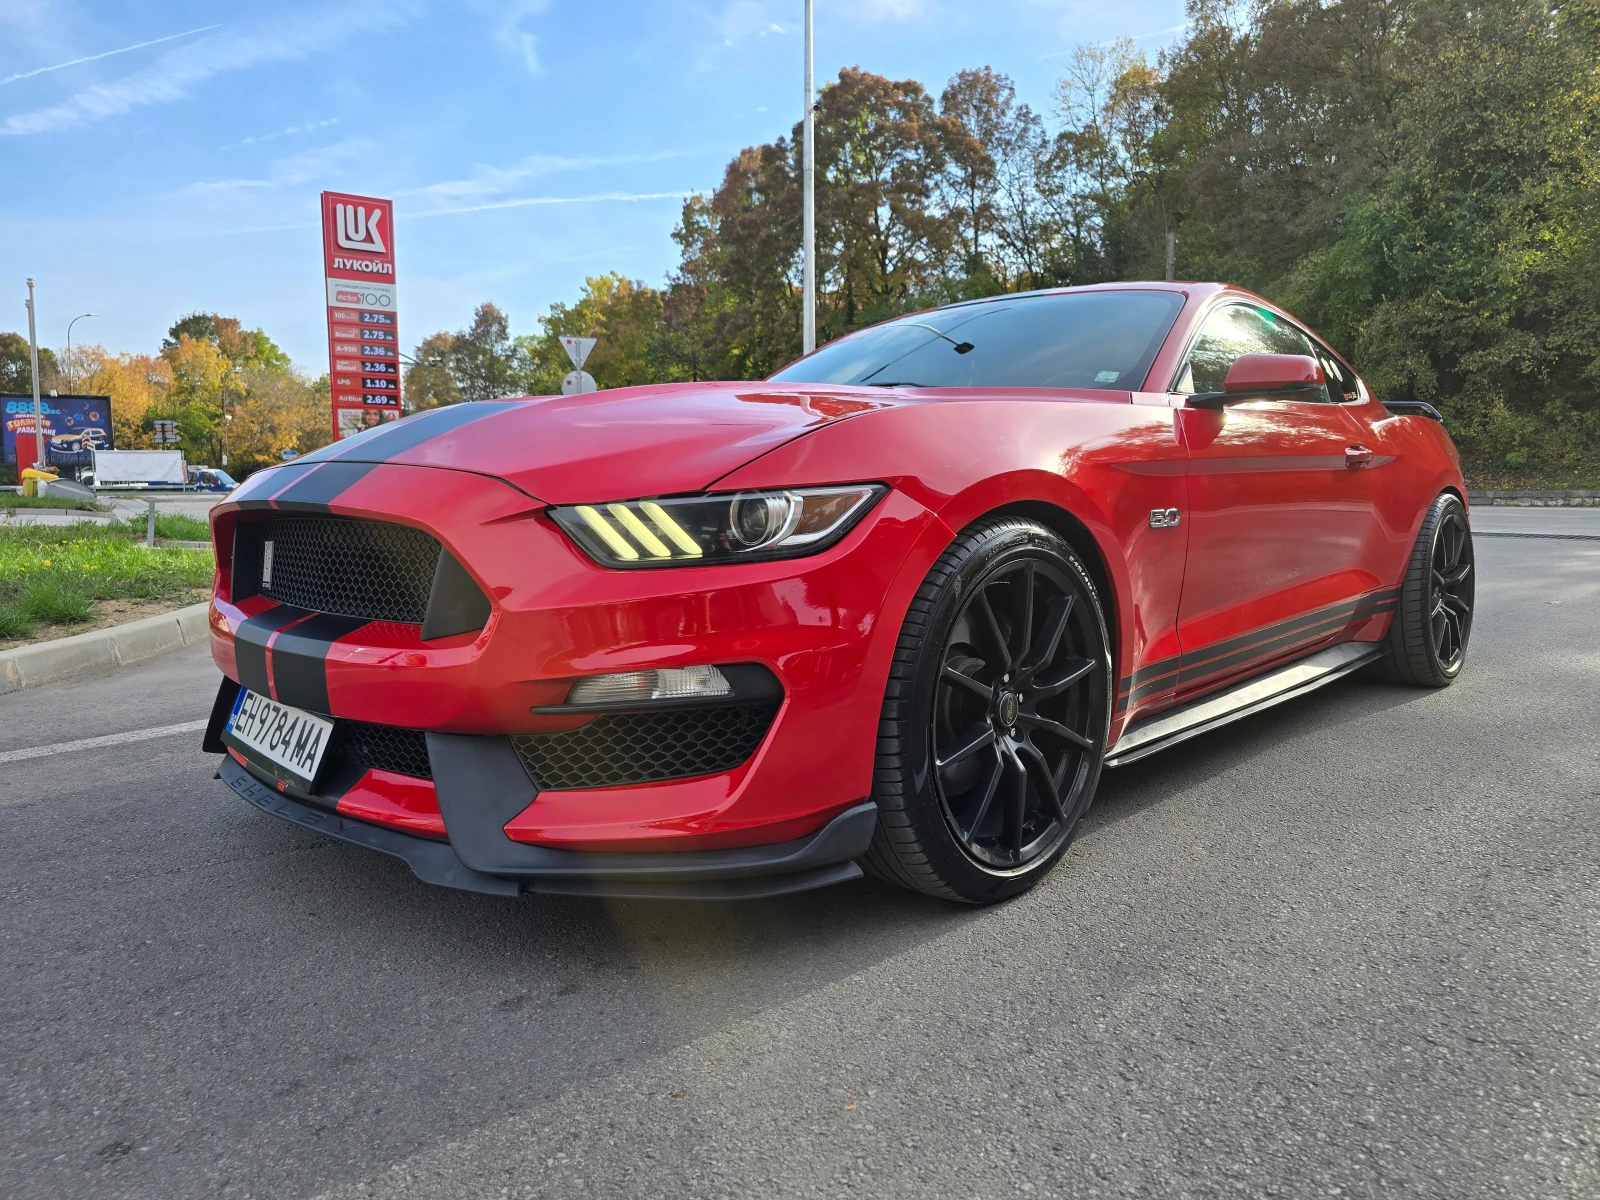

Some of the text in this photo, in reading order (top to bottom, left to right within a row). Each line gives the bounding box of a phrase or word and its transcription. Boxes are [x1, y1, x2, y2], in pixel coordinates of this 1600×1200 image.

[333, 257, 393, 275] ЛУКОЙЛ
[337, 292, 391, 307] ecto 100
[363, 313, 384, 323] 2.75
[363, 329, 385, 340] 2.75
[364, 345, 385, 356] 2.36
[365, 362, 386, 372] 2.36
[366, 379, 387, 388] 1.10
[366, 395, 388, 404] 2.69
[7, 418, 51, 429] ГОЛЯМТО
[1149, 507, 1181, 528] 5.0
